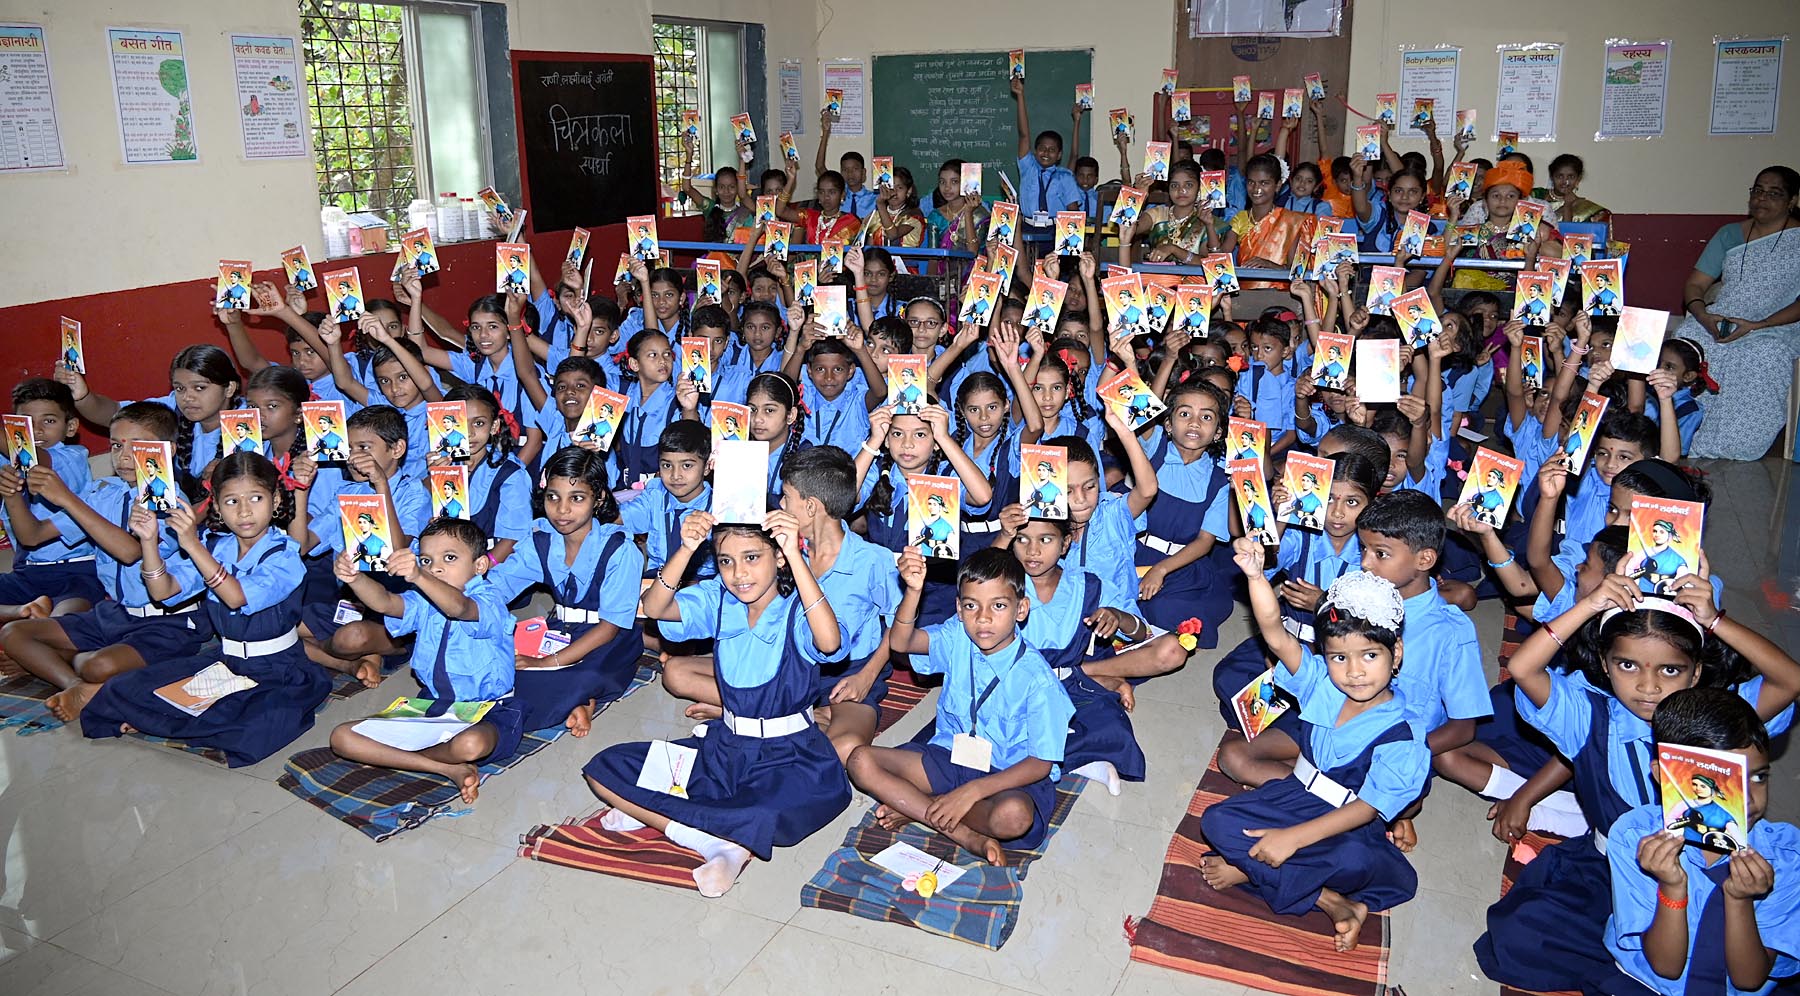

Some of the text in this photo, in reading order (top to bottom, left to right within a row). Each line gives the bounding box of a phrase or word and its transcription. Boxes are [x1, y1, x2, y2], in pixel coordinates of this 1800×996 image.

[0, 33, 38, 47] ज्ञानाशी
[119, 35, 173, 51] बसंत गीत
[1622, 49, 1652, 60] रहस्य
[1724, 45, 1776, 55] सरळव्याज
[1405, 56, 1455, 65] Baby Pangolin
[1507, 52, 1554, 63] शब्द संपदा
[579, 153, 613, 175] स्पर्धा
